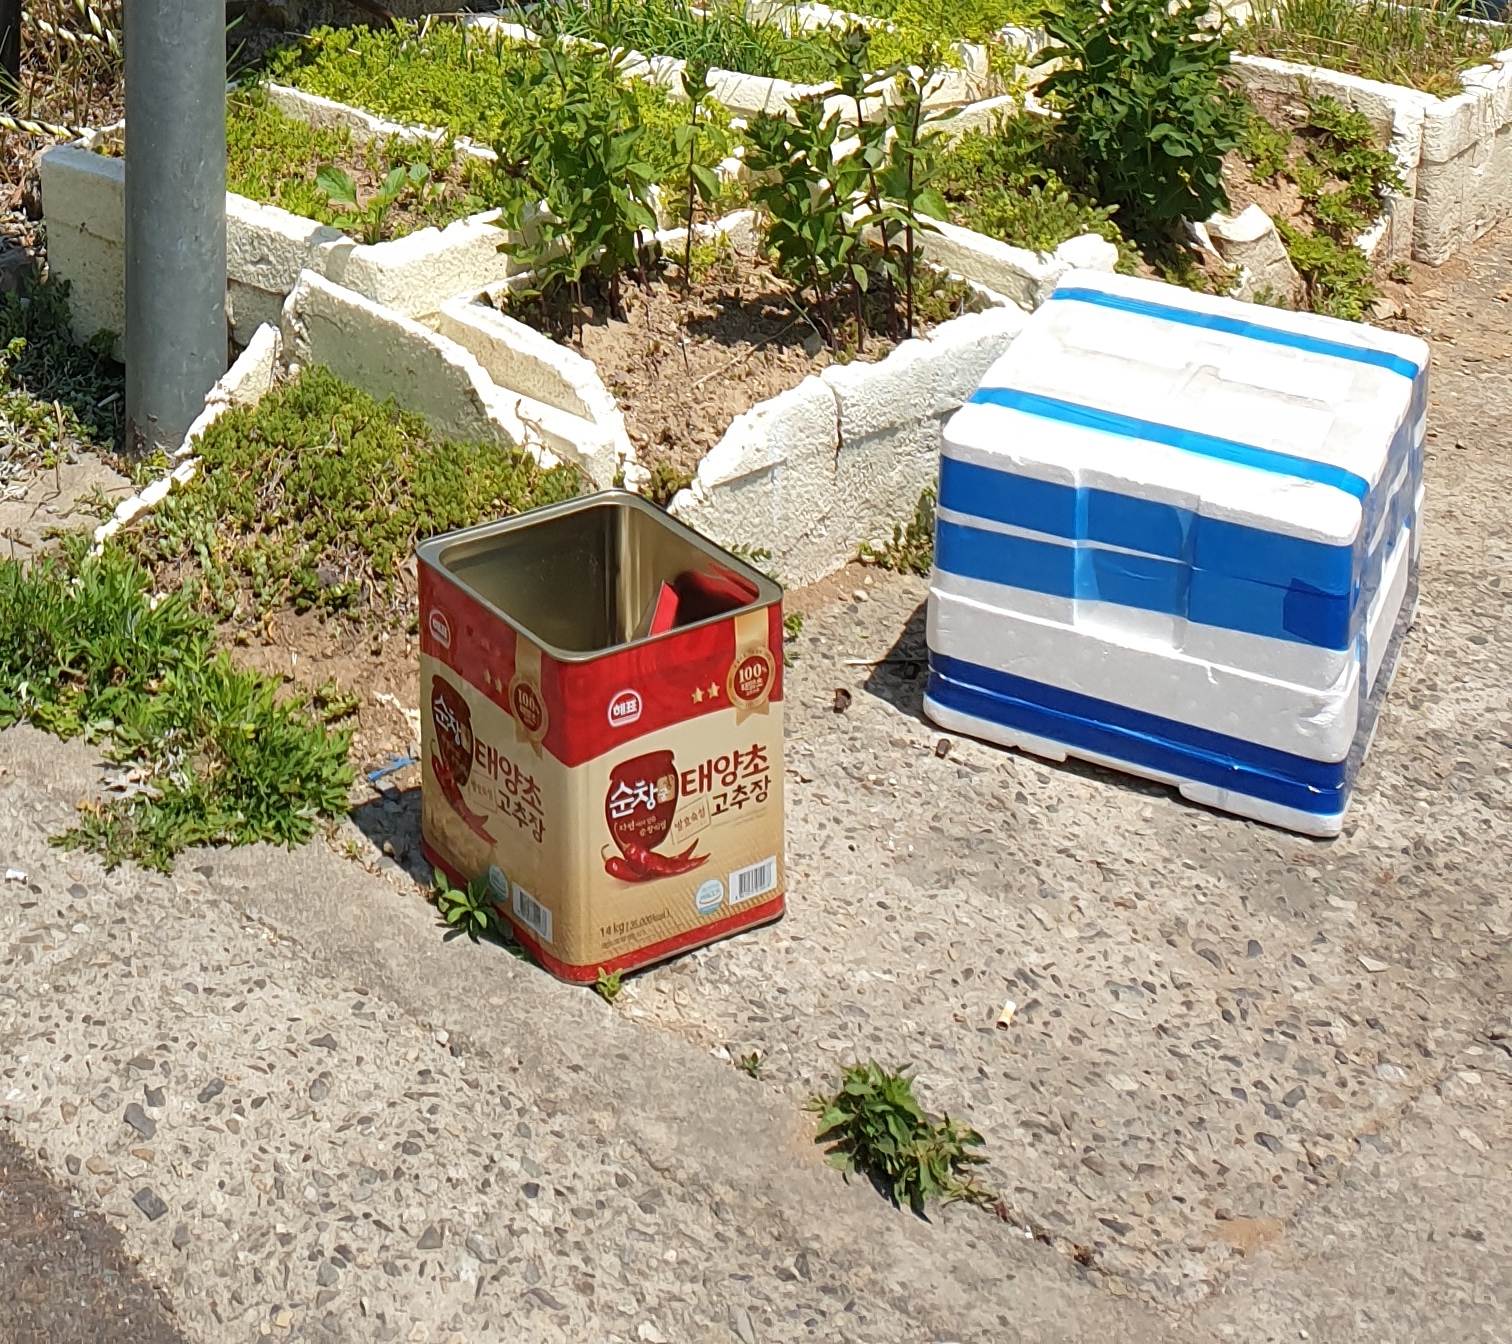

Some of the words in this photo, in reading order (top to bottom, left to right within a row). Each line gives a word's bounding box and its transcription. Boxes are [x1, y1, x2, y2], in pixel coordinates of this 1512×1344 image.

[613, 698, 637, 716] 해표
[474, 737, 545, 817] 태양초
[681, 744, 770, 797] 태양초
[711, 775, 772, 816] 고추장
[497, 789, 546, 844] 고추장
